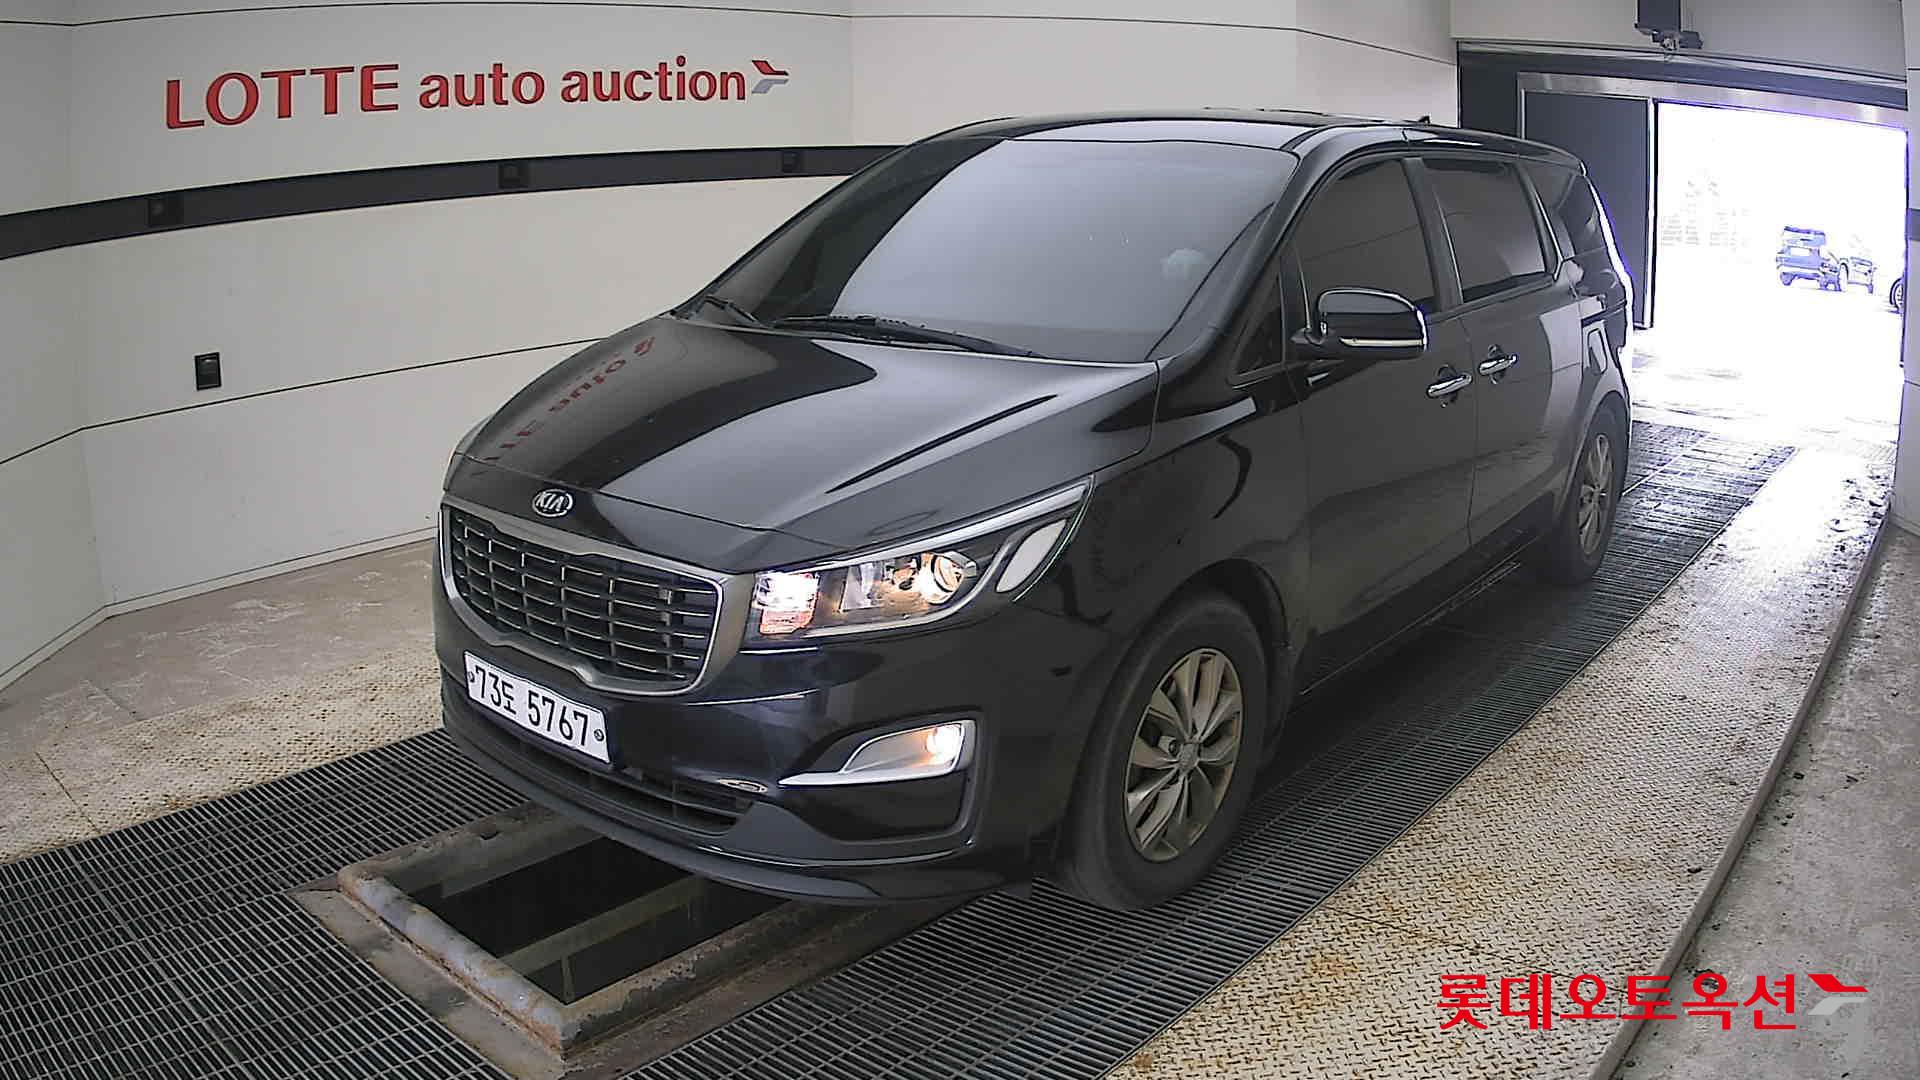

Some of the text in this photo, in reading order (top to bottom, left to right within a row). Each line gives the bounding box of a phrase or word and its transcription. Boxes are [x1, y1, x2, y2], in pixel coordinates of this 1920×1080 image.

[165, 55, 746, 129] LOTTE auto auction
[535, 491, 566, 512] KIA
[475, 665, 588, 746] 73도 5767
